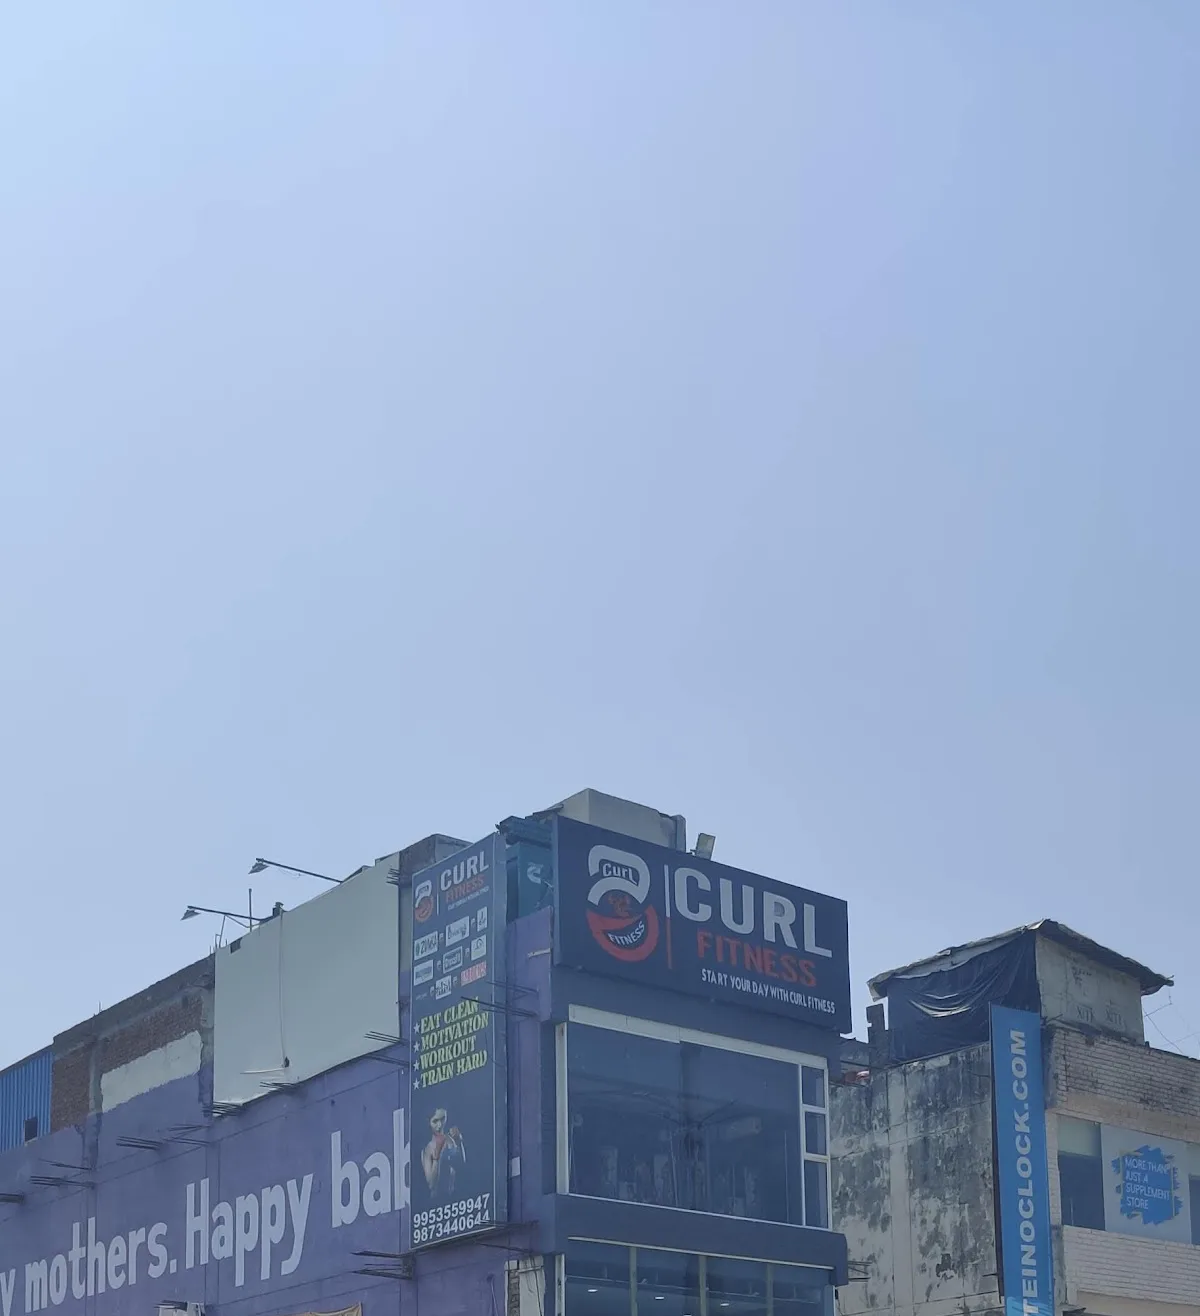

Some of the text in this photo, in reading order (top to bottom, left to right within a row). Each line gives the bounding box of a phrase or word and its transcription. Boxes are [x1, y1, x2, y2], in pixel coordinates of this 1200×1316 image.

[440, 851, 489, 891] CURL
[674, 867, 832, 958] CURL
[608, 920, 645, 946] FITNESS
[696, 930, 817, 987] FITNESS
[701, 968, 836, 1014] START YOUR DAY WITH CURL FITNESS
[420, 996, 479, 1034] EAT CLEAN
[420, 1011, 489, 1053] MOTIVATION
[420, 1035, 476, 1070] WORKOUT
[420, 1050, 487, 1088] TRAIN HARD
[1124, 1156, 1148, 1171] MORE
[1125, 1170, 1149, 1184] JUST A
[413, 1192, 490, 1228] 9953559947
[1125, 1182, 1171, 1201] SUPPLEMENT
[1126, 1196, 1149, 1210] STORE
[25, 1216, 177, 1313] mothers.
[185, 1173, 313, 1288] Happy
[413, 1209, 490, 1244] 9873440644
